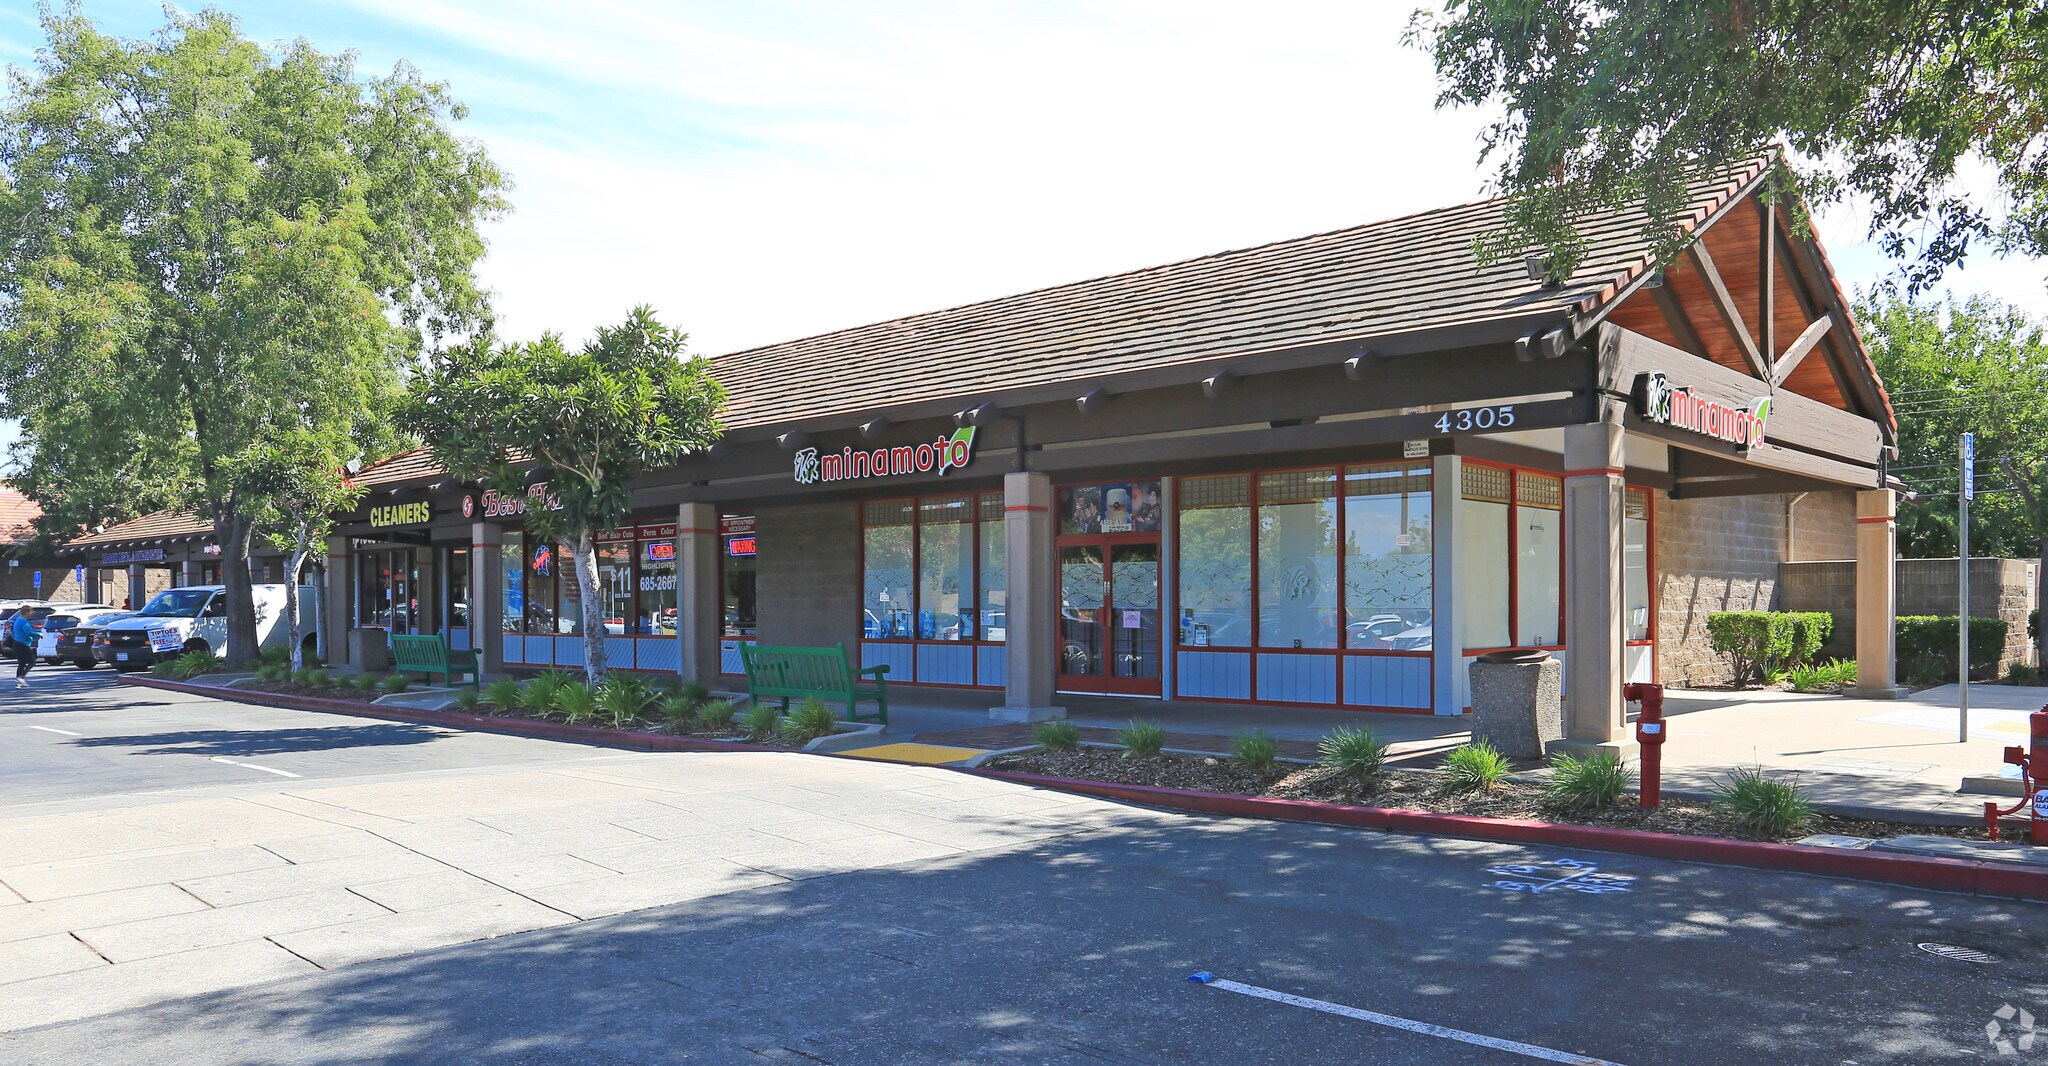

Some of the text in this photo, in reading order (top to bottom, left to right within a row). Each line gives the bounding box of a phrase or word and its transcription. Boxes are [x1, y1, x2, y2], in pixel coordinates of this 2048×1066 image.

[1434, 405, 1516, 434] 4305
[1671, 385, 1765, 450] minamoto
[821, 435, 970, 482] minamoto
[370, 501, 430, 528] CLEANERS
[609, 530, 621, 539] Hair
[622, 530, 634, 538] Cuts
[643, 527, 675, 537] Perm Color
[651, 545, 673, 558] OPEN
[731, 539, 756, 554] WAXING
[641, 562, 676, 570] HIGHLIGHTS
[640, 575, 677, 592] 685-2667
